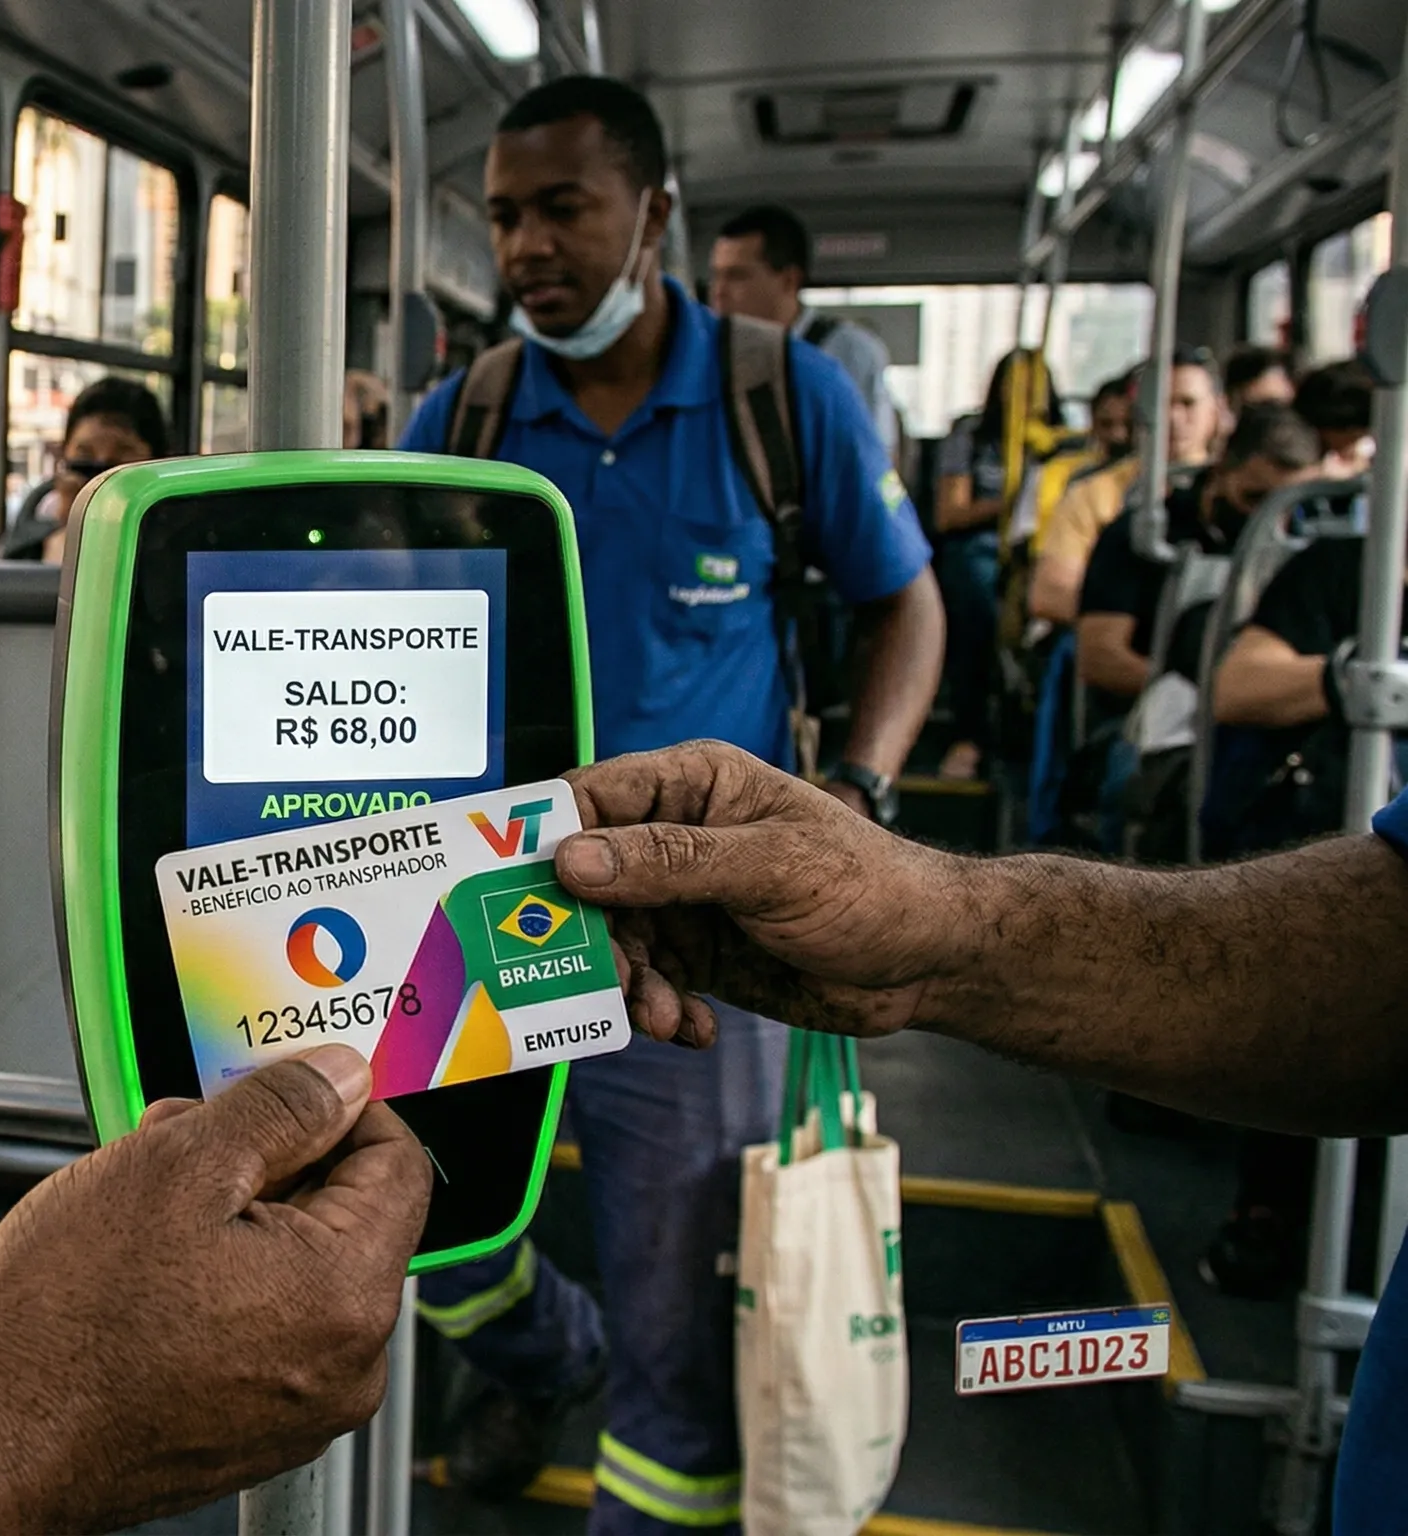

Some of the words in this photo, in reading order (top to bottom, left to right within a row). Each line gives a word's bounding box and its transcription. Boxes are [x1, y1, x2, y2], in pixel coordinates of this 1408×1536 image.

[213, 627, 478, 652] VALE-TRANSPORTE
[284, 679, 407, 707] SALDO:
[276, 716, 319, 749] R$
[330, 716, 417, 750] 68,00
[260, 791, 432, 819] APROVADO
[466, 797, 554, 859] VT
[175, 822, 441, 893] VALE-TRANSPORTE
[190, 884, 282, 917] BENÉFICIO
[286, 878, 312, 898] AO
[313, 852, 447, 892] TRANSPHADOR
[498, 956, 592, 988] BRAZISIL
[237, 982, 423, 1049] 12345678
[524, 1019, 613, 1053] EMTU/SP
[1047, 1320, 1086, 1333] EMTU
[978, 1332, 1149, 1385] ABC1D23
